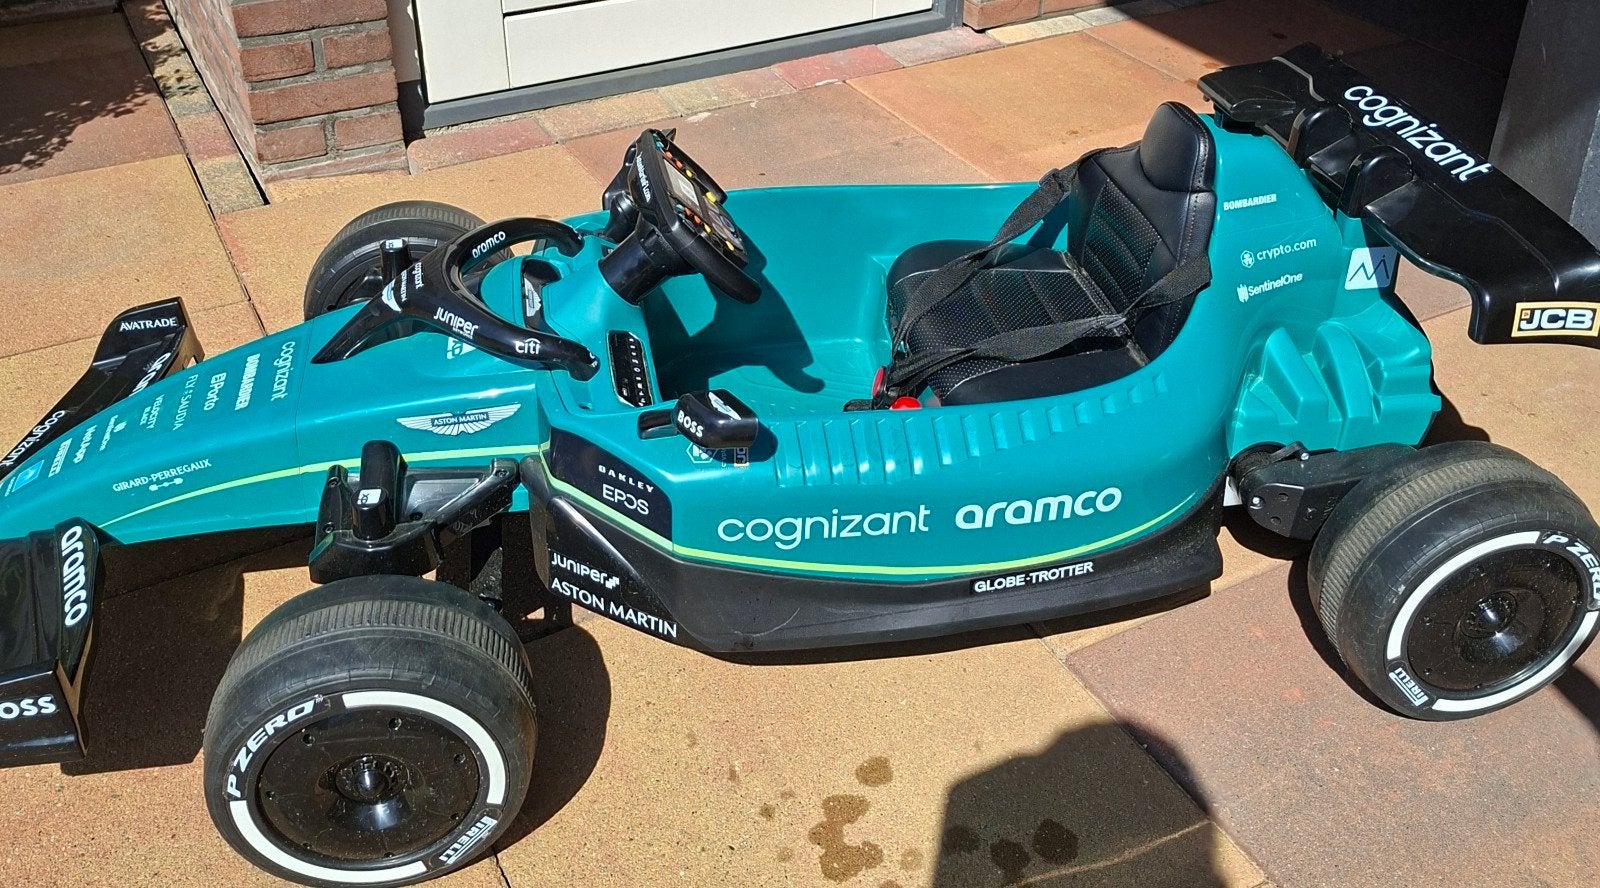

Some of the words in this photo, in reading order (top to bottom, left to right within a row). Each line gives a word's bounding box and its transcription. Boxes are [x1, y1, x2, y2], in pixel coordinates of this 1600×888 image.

[1343, 85, 1492, 181] cognizant
[1223, 193, 1277, 211] BOMBARDIER
[1256, 238, 1317, 261] crypto.com
[1248, 273, 1303, 297] SentinelOne
[119, 317, 178, 332] AVATRADE
[1519, 308, 1594, 330] JCB
[515, 338, 541, 355] citi
[235, 353, 260, 411] BOMBARDIER
[271, 341, 296, 401] cognizant
[433, 415, 458, 425] ASTON
[459, 413, 487, 422] MARTIN
[678, 409, 704, 438] BOSS
[0, 410, 66, 466] cognizant
[113, 459, 212, 492] GIRARD-PERREGAUX
[598, 464, 654, 493] OAKLEY
[602, 484, 649, 516] EPOS
[717, 505, 930, 551] cognizant
[955, 487, 1123, 530] aramco
[1542, 534, 1569, 544] P
[61, 525, 88, 627] aramco
[974, 561, 1094, 593] GLOBE-TROTTER
[551, 577, 605, 612] ASTON
[609, 602, 677, 638] MARTIN
[1389, 667, 1429, 707] PIRELLI
[0, 696, 56, 719] OSS
[233, 699, 316, 773] ZERO
[227, 774, 242, 797] P
[438, 816, 498, 865] PIRELLI
